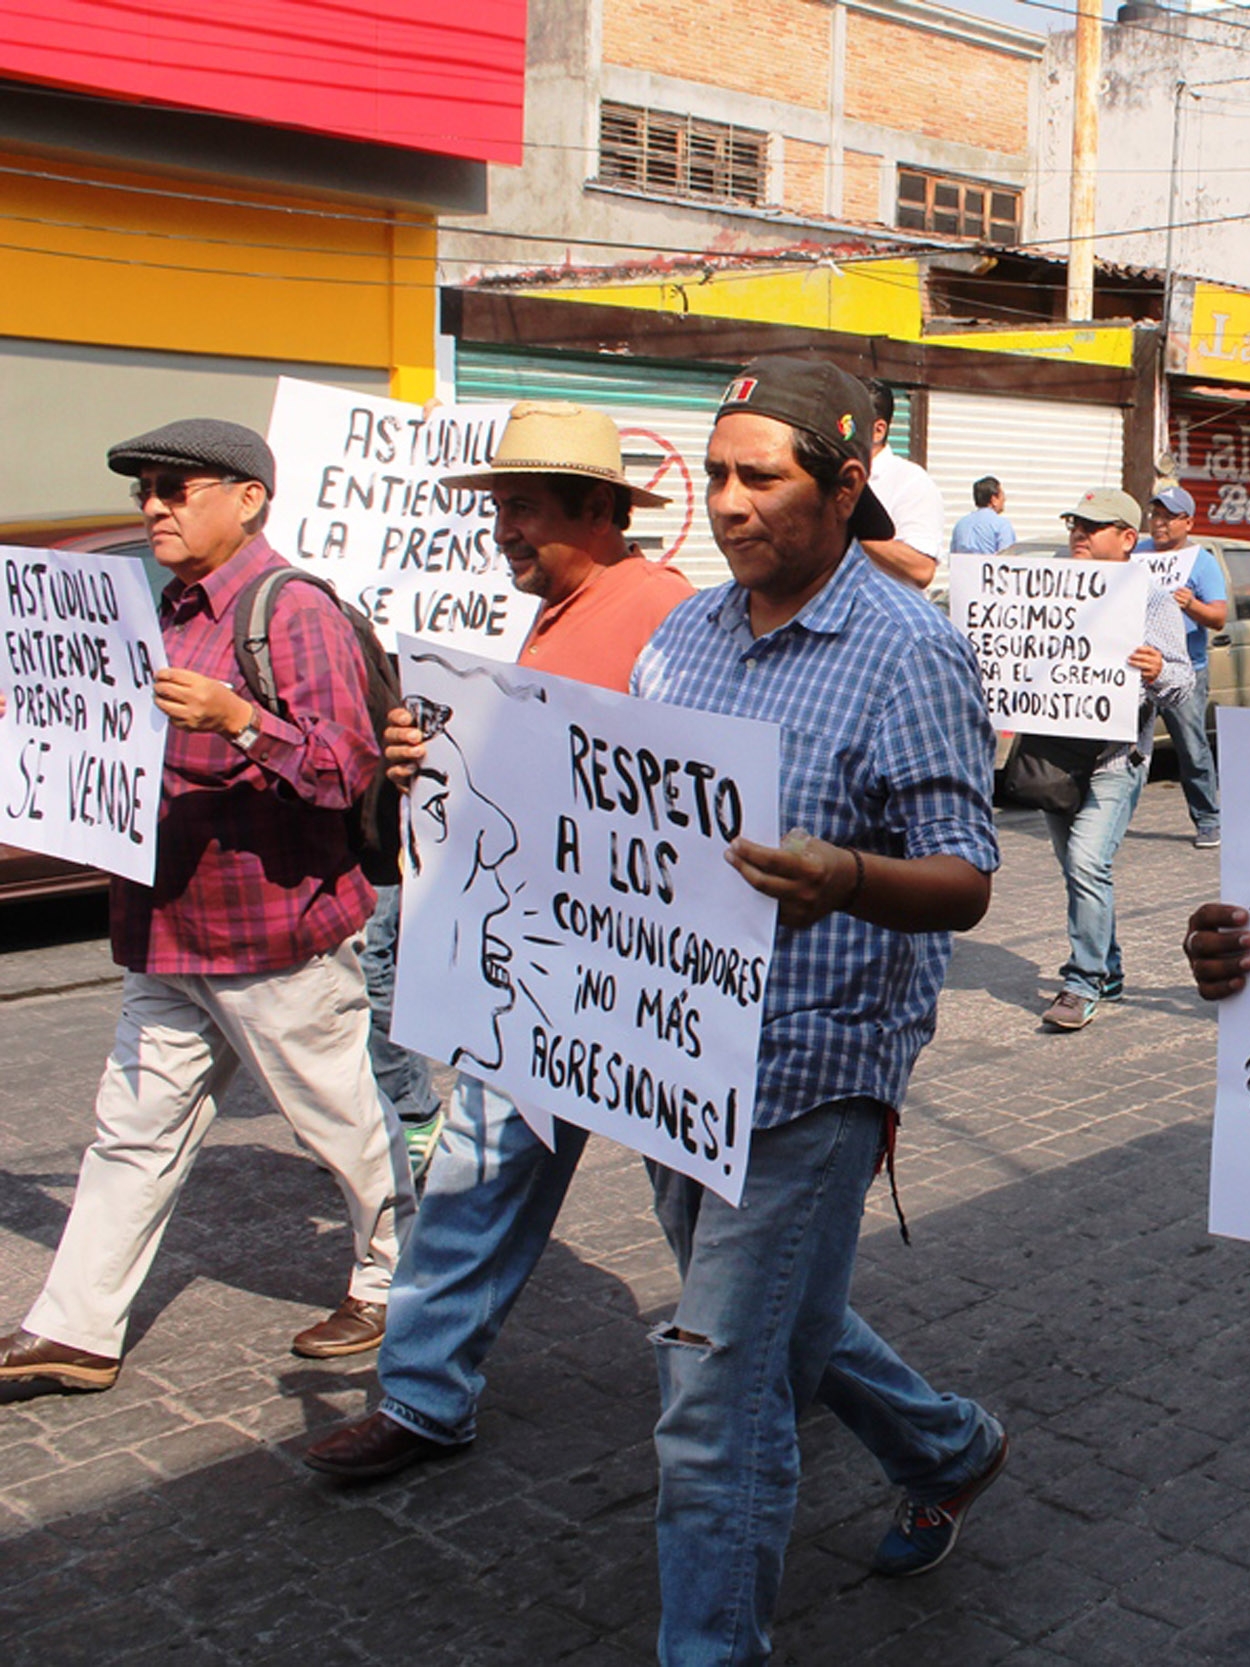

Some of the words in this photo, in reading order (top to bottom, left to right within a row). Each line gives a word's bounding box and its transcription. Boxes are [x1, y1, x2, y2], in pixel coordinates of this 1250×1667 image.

[344, 407, 496, 468] ASTUDILL
[297, 517, 348, 559] LA
[378, 527, 504, 576] PRENS
[6, 559, 119, 625] ASTUDILLO
[358, 586, 393, 624] SE
[413, 590, 508, 636] VENDE
[981, 562, 1106, 601] ASTUDILLO
[967, 601, 1077, 631] EXIGIMOS
[5, 627, 116, 686] ENTIENDE
[126, 639, 154, 689] LA
[967, 632, 1092, 662] SEGURIDAD
[1013, 663, 1033, 683] EL
[1051, 667, 1126, 687] GREMIO
[14, 684, 88, 732] PRENSA
[102, 699, 133, 743] NO
[6, 738, 51, 819] SE
[68, 750, 146, 844] VENDE
[569, 723, 743, 842] RESPETO
[557, 815, 581, 873] A
[610, 831, 678, 905] LOS
[553, 892, 765, 1007] COMUNICADORES
[532, 1025, 738, 1177] AGRESIONES!
